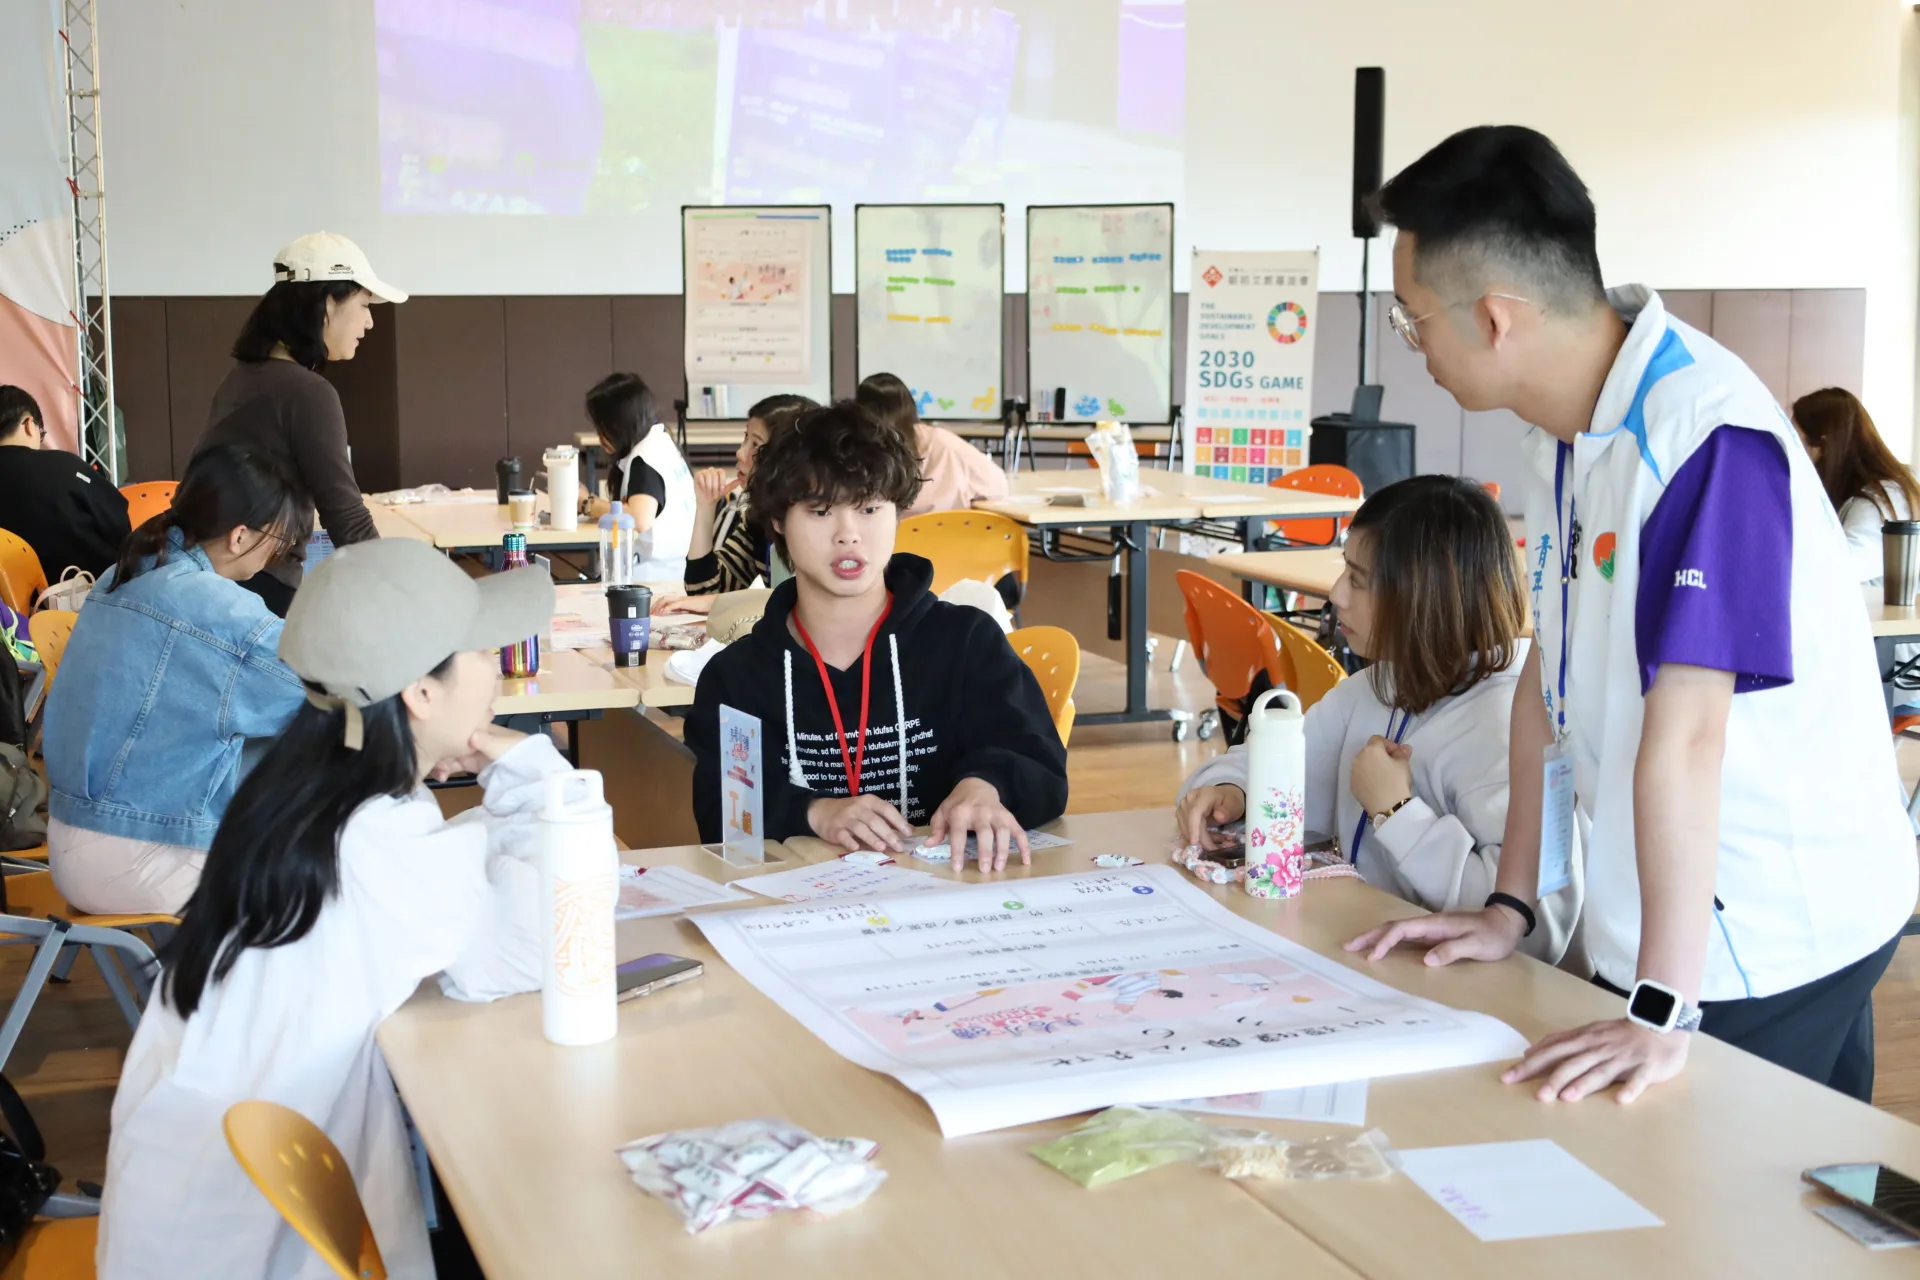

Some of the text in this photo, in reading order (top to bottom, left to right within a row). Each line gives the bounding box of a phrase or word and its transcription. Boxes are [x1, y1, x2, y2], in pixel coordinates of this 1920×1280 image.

[1199, 350, 1255, 368] 2030
[1259, 376, 1304, 390] GAME
[1673, 568, 1707, 590] HCL
[894, 718, 921, 732] CRPE
[864, 782, 886, 792] desert
